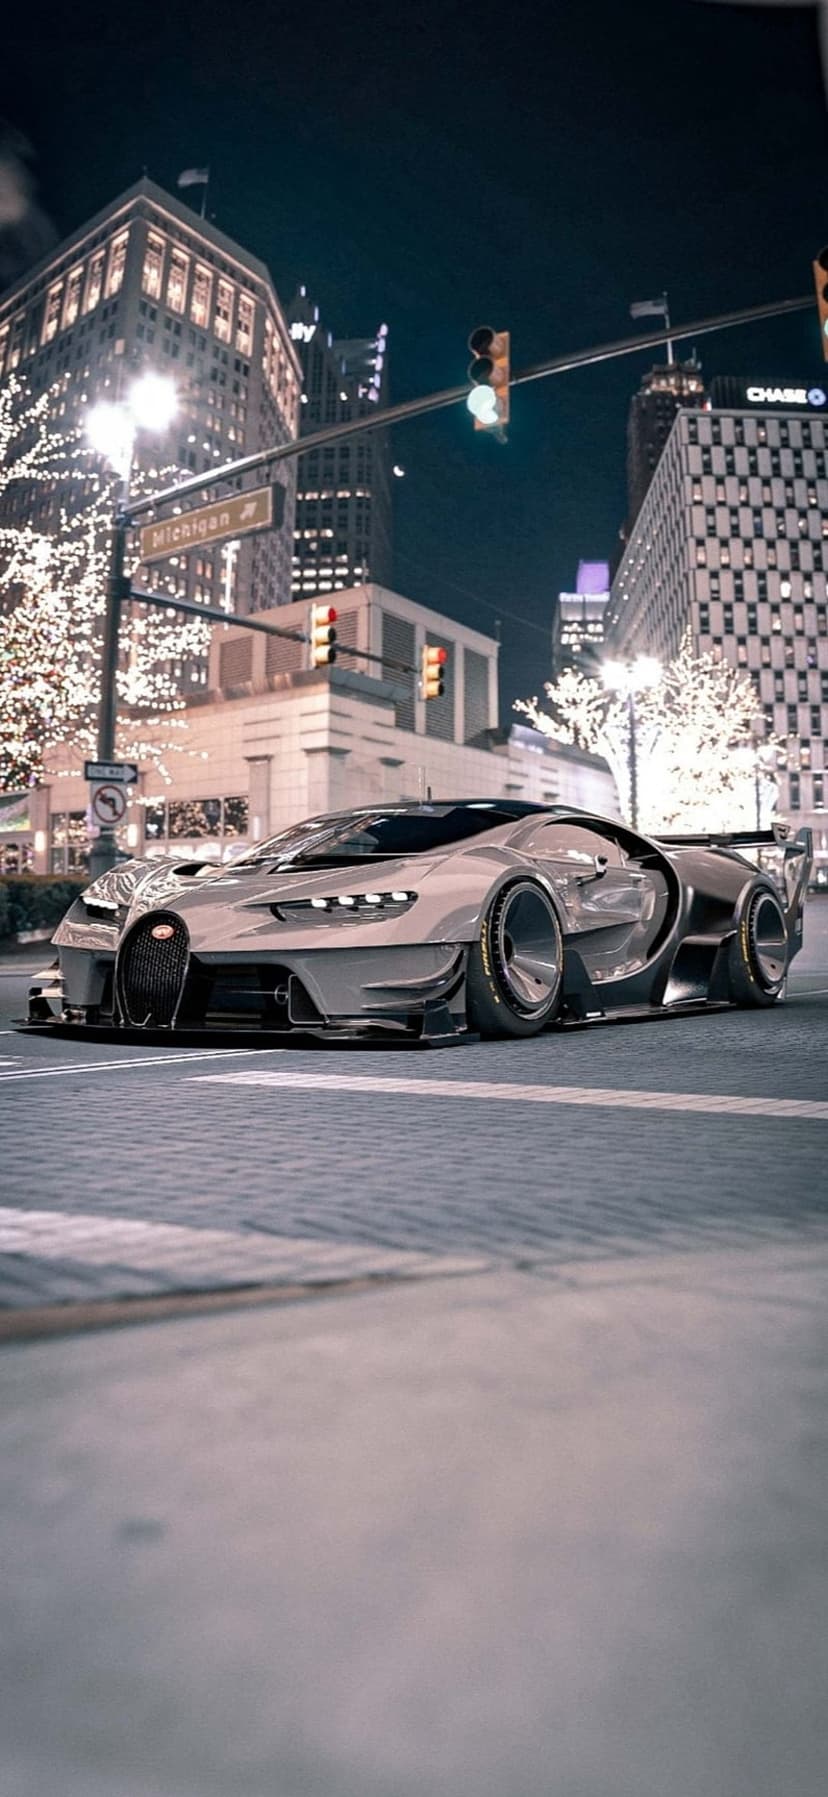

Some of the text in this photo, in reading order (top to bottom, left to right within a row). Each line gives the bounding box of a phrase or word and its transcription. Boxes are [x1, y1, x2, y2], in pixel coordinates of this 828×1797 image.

[289, 322, 316, 343] lly
[746, 387, 808, 403] CHASE
[152, 512, 230, 548] Michigan
